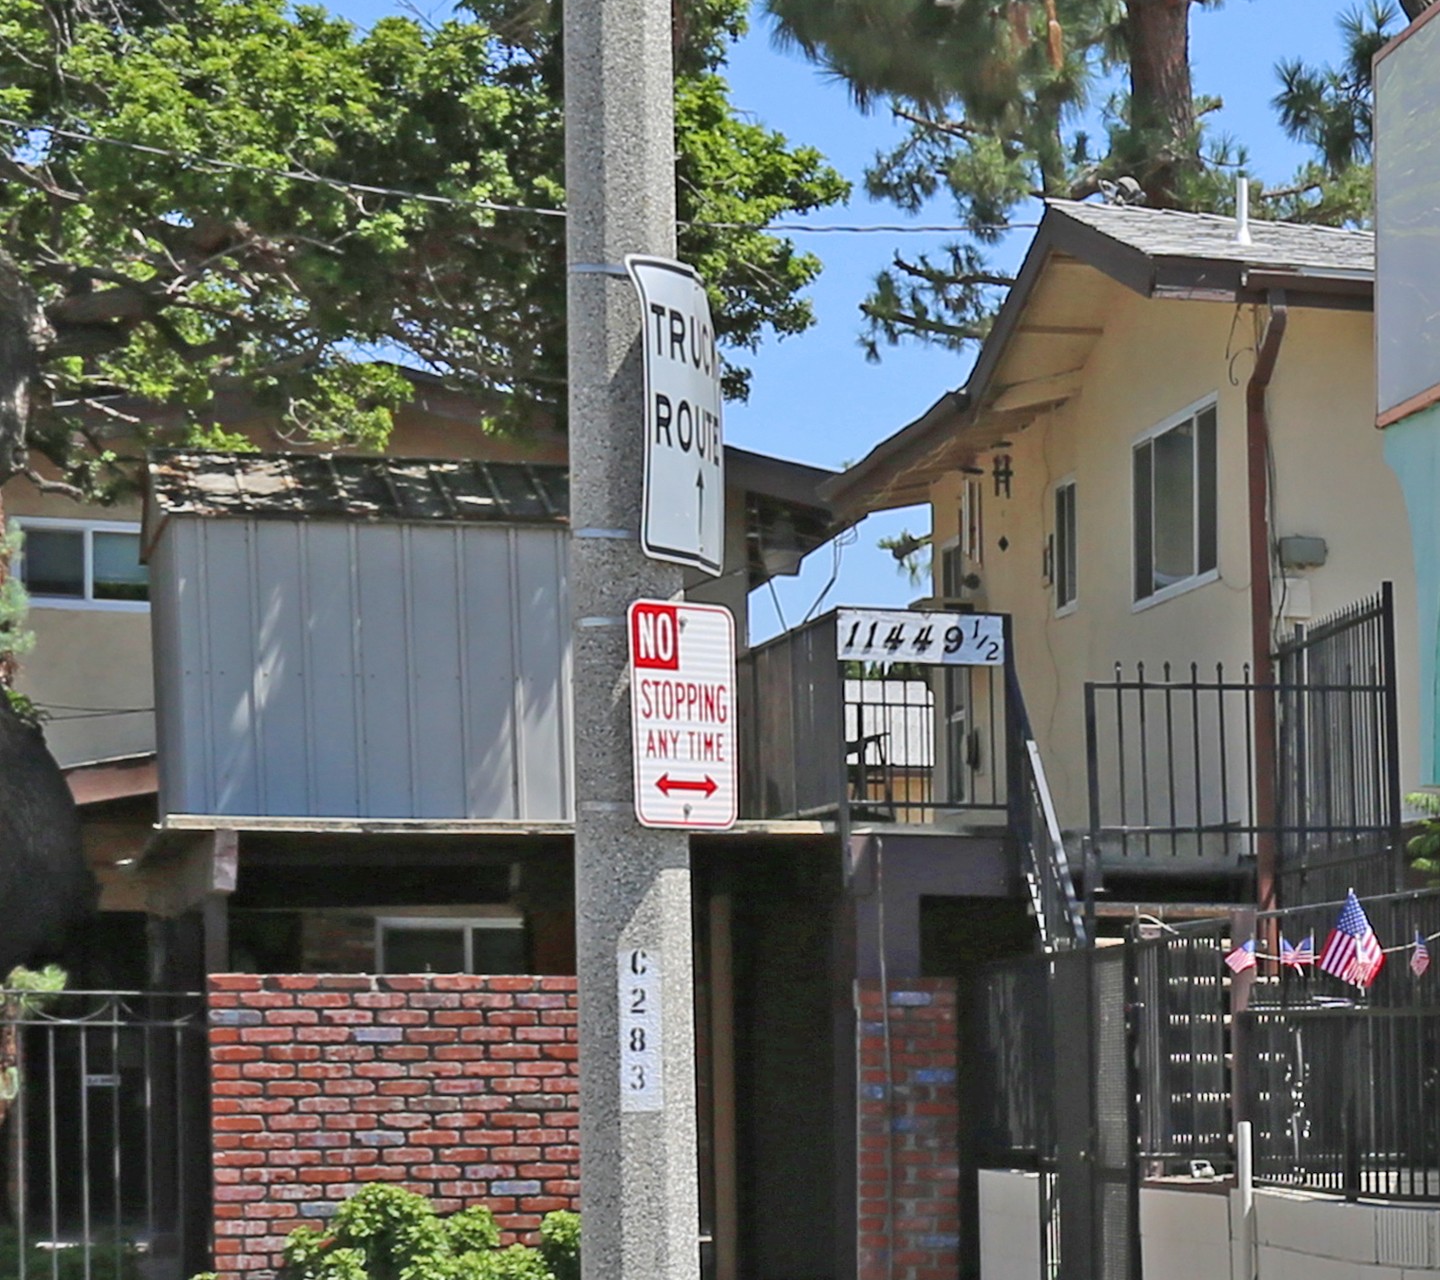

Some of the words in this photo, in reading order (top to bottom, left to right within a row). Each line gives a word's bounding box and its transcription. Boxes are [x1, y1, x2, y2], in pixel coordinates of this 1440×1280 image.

[655, 391, 720, 467] ROUTE
[638, 612, 674, 662] NO
[845, 621, 963, 654] 11449
[641, 679, 728, 724] STOPPING
[646, 729, 680, 760] ANY
[688, 731, 726, 762] TIME
